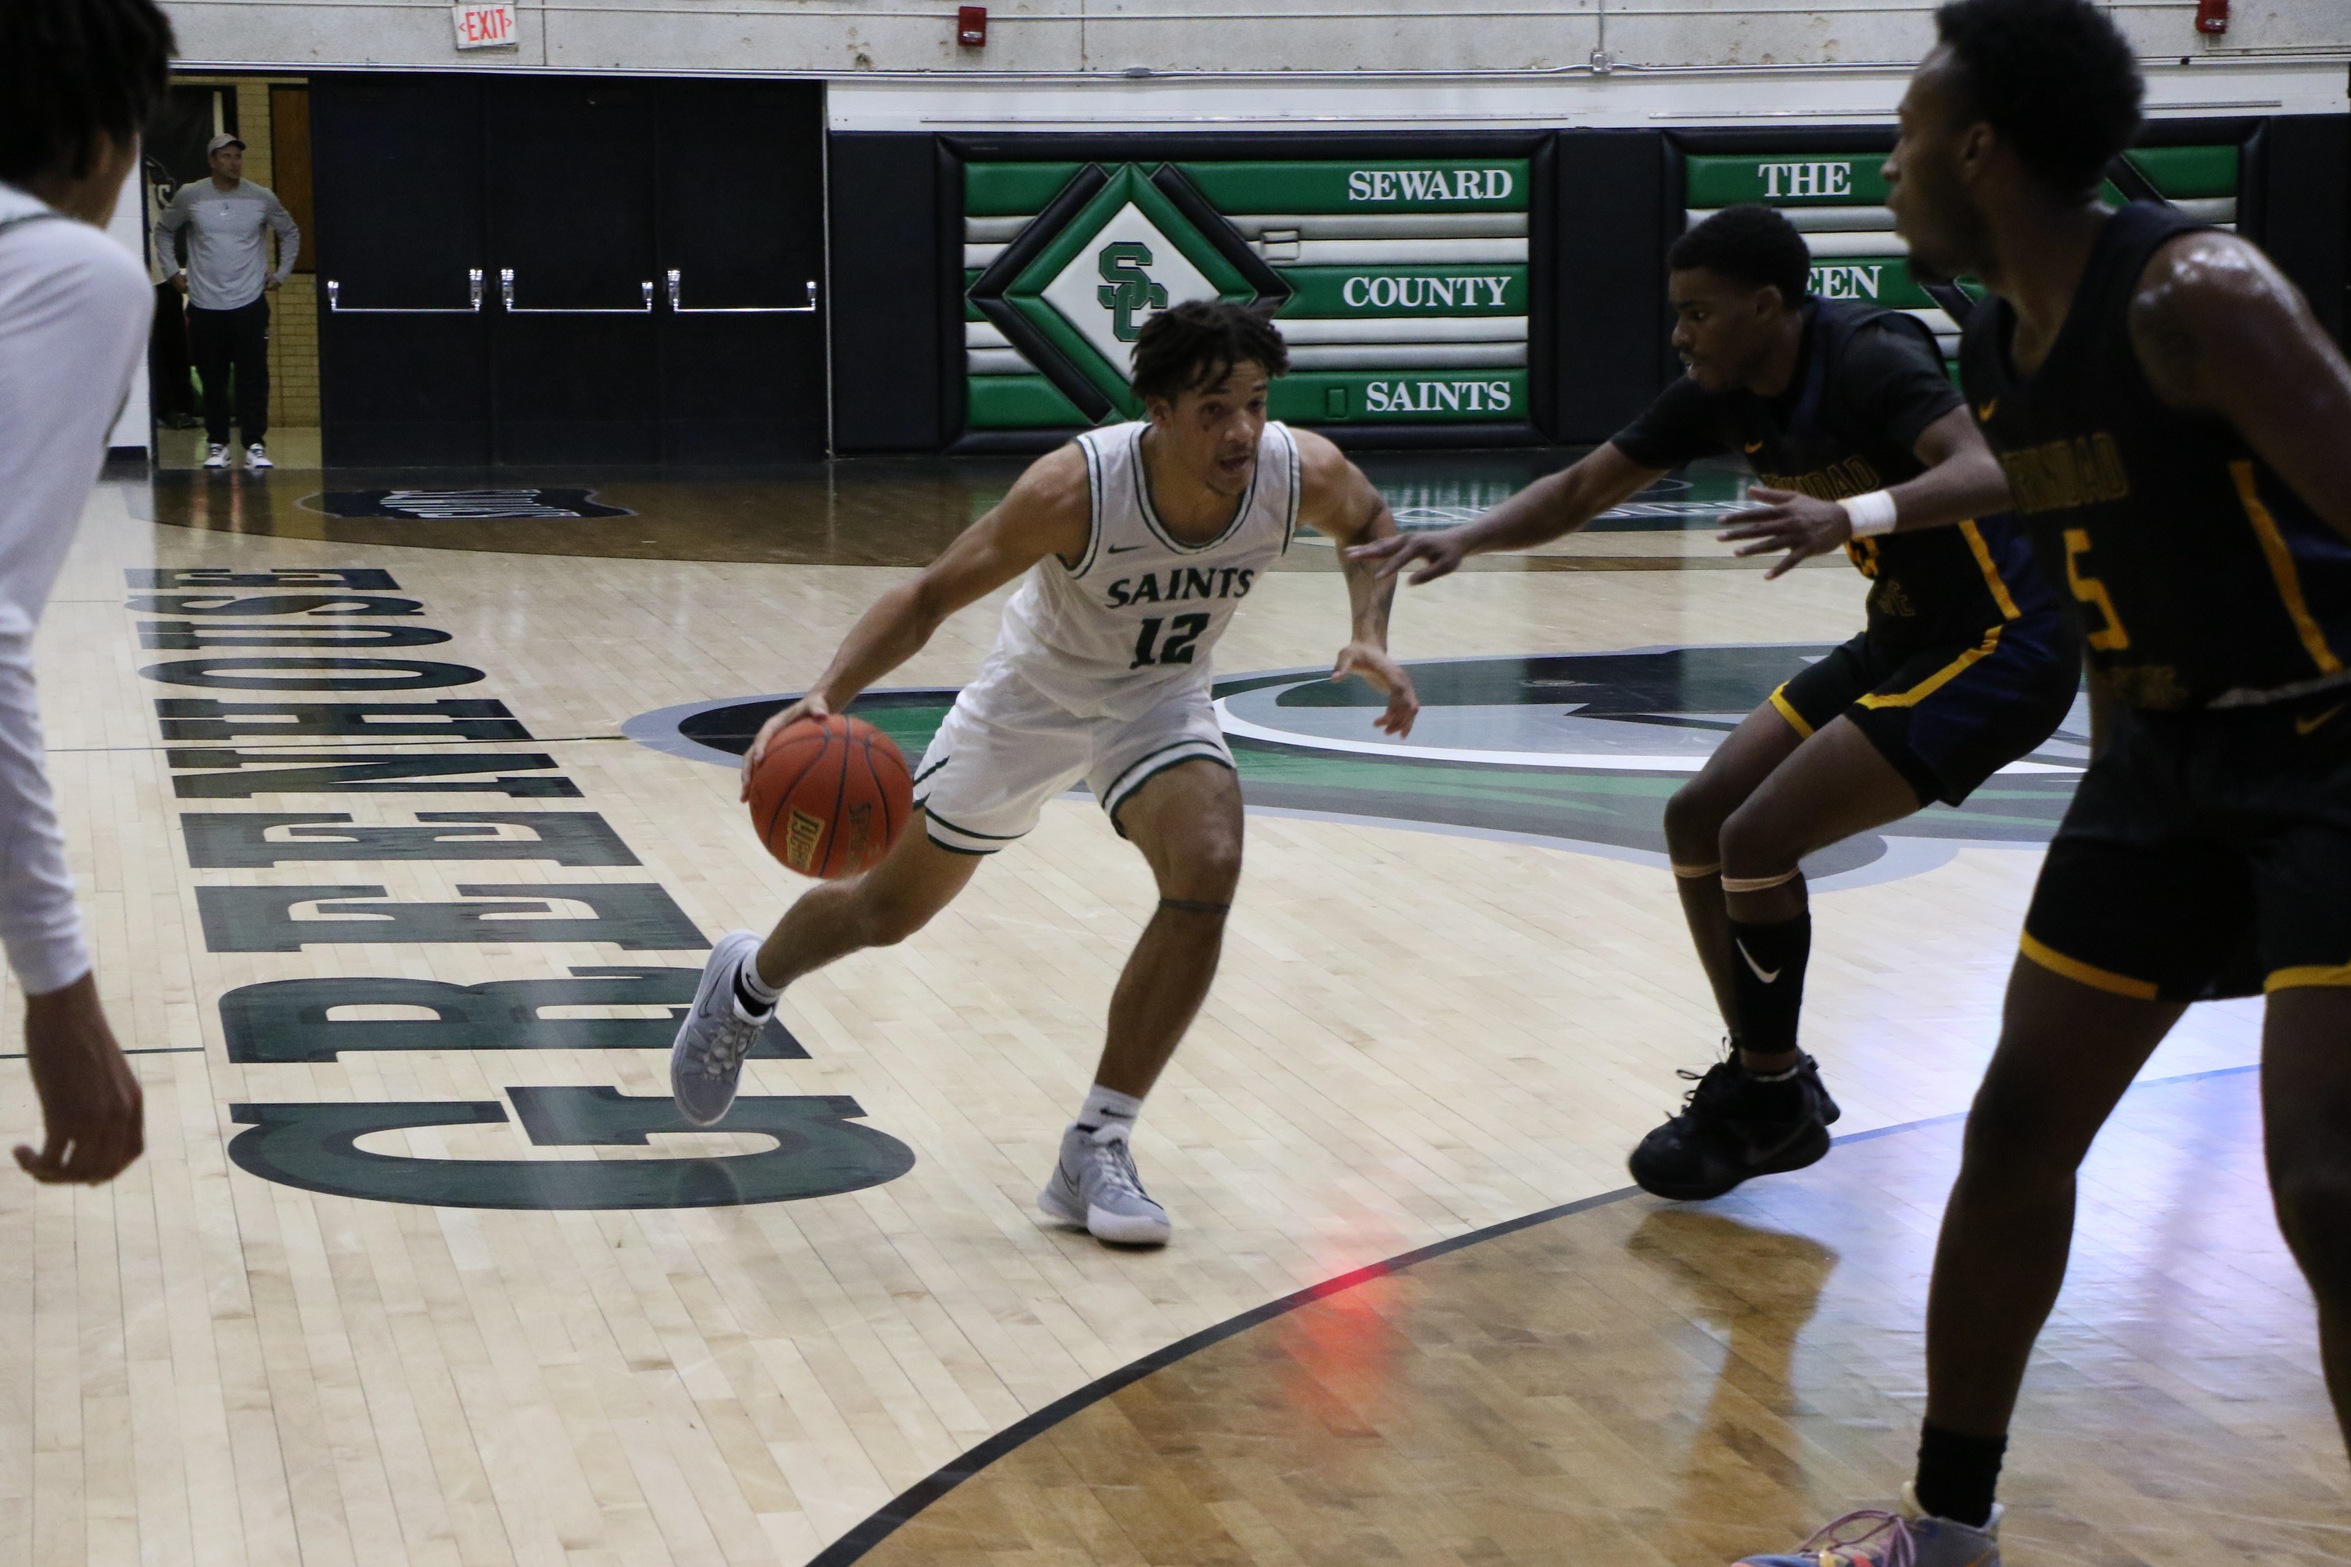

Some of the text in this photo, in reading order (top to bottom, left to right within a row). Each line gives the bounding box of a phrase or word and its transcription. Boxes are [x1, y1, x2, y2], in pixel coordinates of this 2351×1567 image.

[466, 9, 506, 41] EXIT
[1348, 169, 1513, 201] SEWARD
[1758, 162, 1852, 198] THE
[1342, 276, 1512, 307] COUNTY
[1805, 265, 1883, 299] EEN
[1365, 381, 1511, 411] SAINTS
[1104, 567, 1254, 609] SAINTS
[2061, 527, 2131, 651] 5
[1129, 612, 1211, 670] 12
